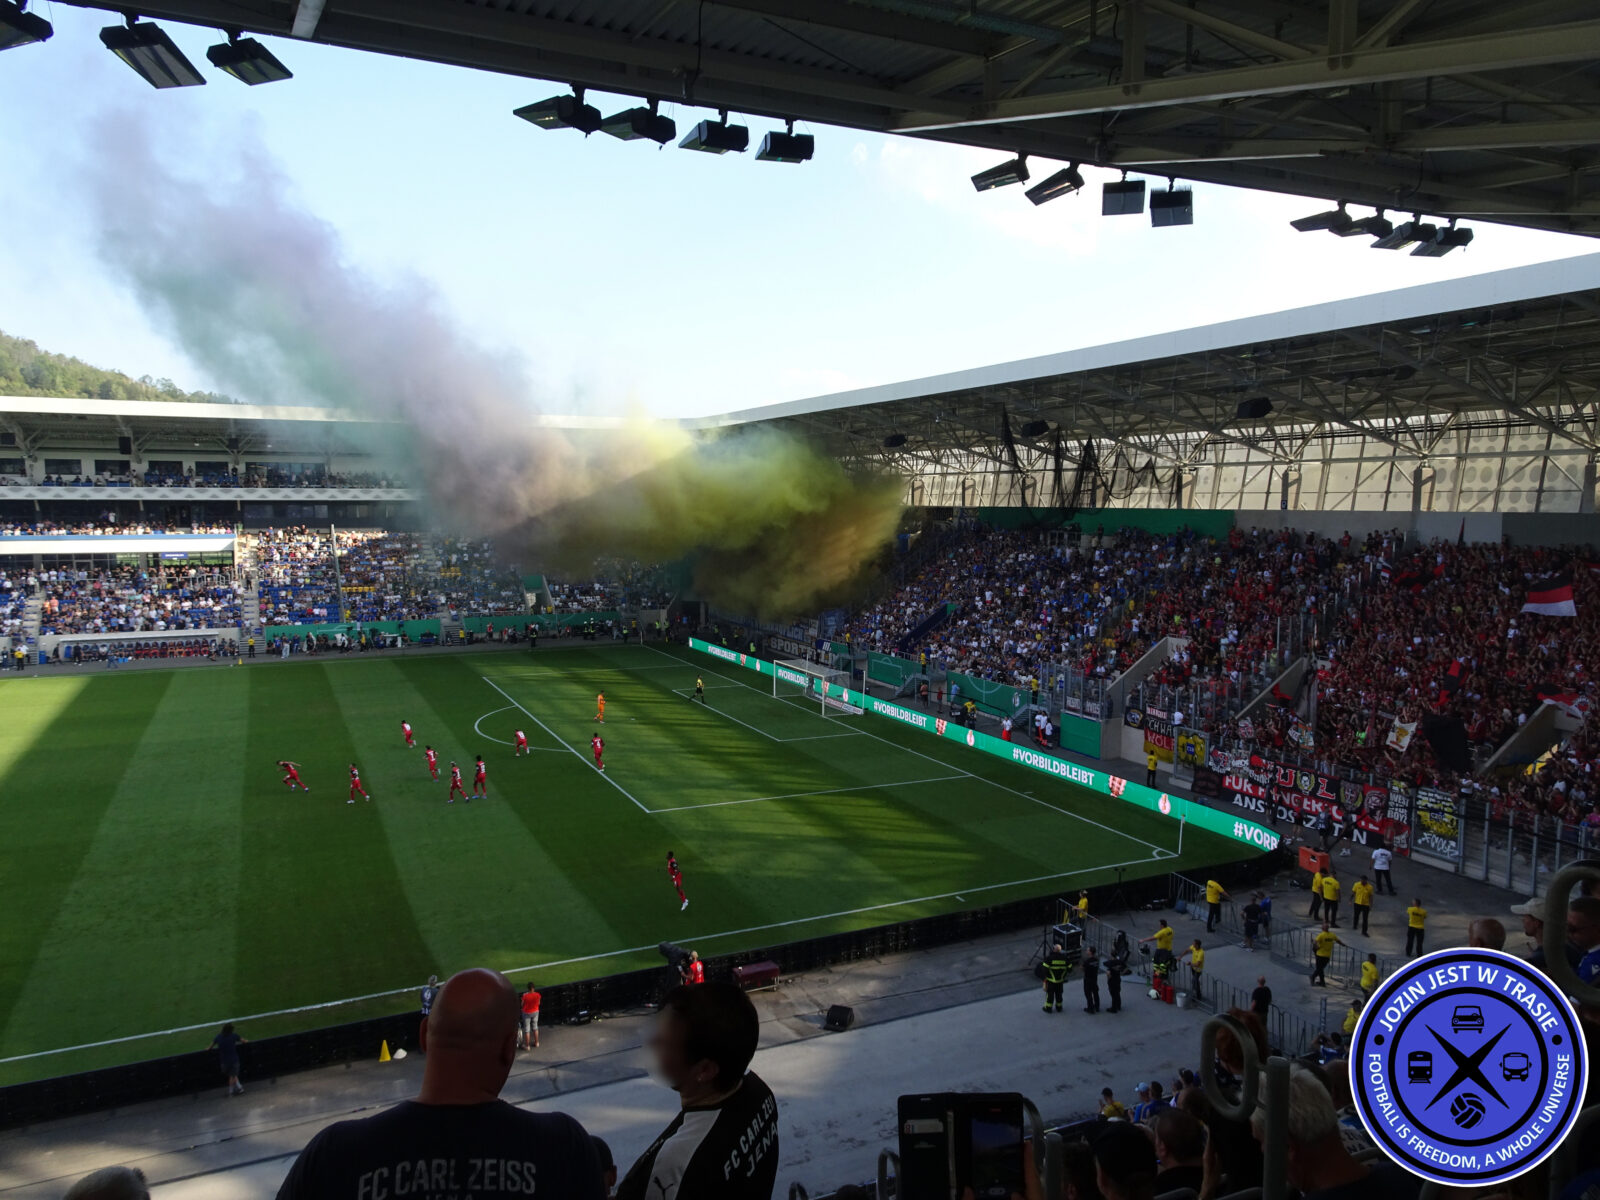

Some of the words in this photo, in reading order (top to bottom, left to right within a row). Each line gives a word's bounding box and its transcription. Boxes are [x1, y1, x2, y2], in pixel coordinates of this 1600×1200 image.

[874, 700, 927, 728] #VORBILDBLEIBT
[1013, 747, 1095, 785] #VORBILDBLEIBT
[724, 1148, 741, 1181] FC
[739, 1112, 765, 1154] CARL
[746, 1121, 778, 1177] JENA
[358, 1167, 389, 1200] FC
[394, 1158, 461, 1196] CARL
[467, 1158, 537, 1195] ZEISS
